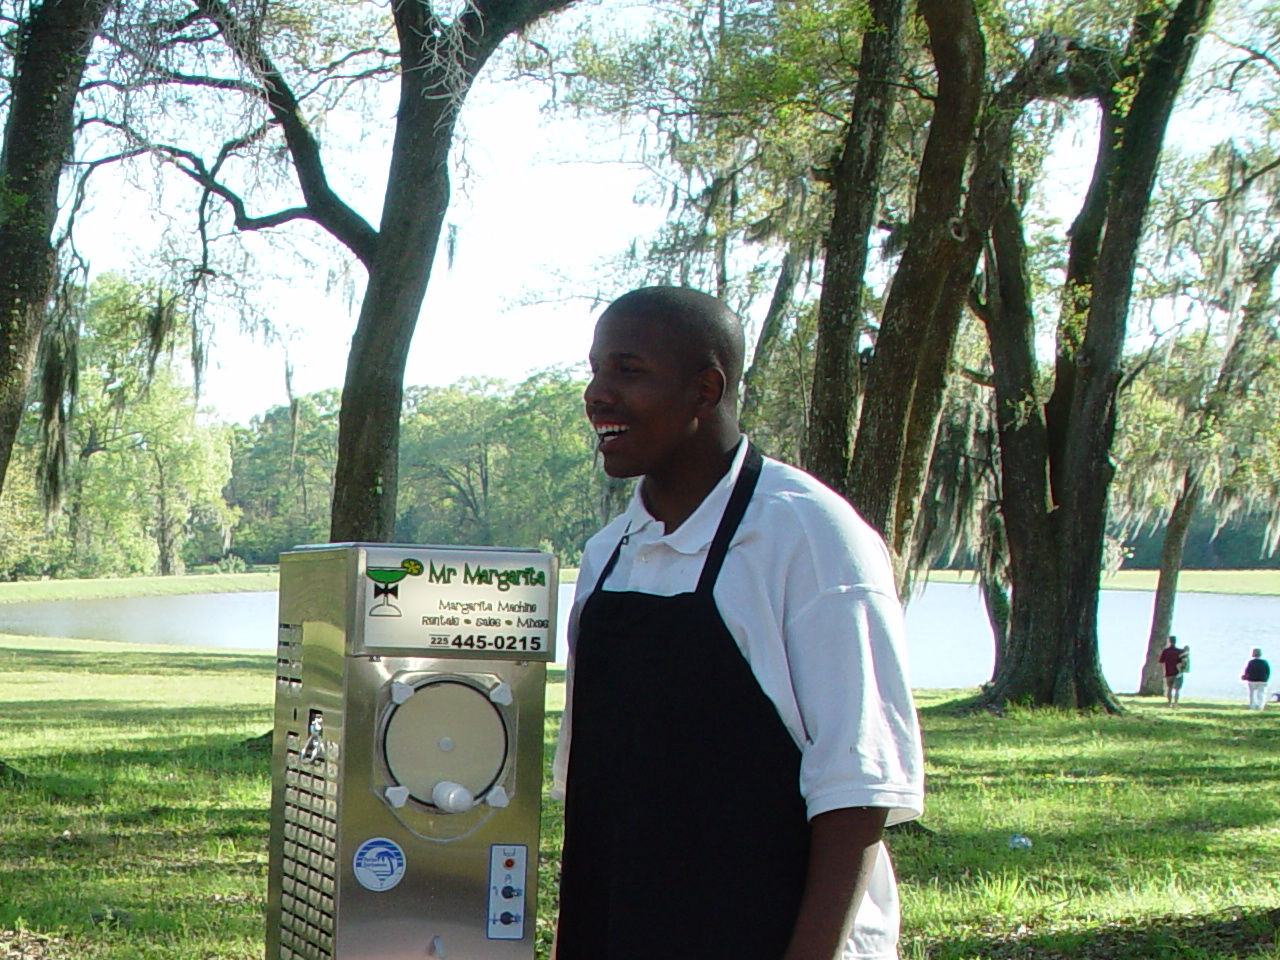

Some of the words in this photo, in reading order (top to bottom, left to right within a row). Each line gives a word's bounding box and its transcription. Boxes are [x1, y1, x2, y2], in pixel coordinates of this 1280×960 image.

[428, 559, 457, 585] Mr
[463, 562, 546, 591] Margarita
[438, 599, 493, 614] Margarita
[497, 601, 537, 613] Machine
[451, 634, 541, 650] 445-0215
